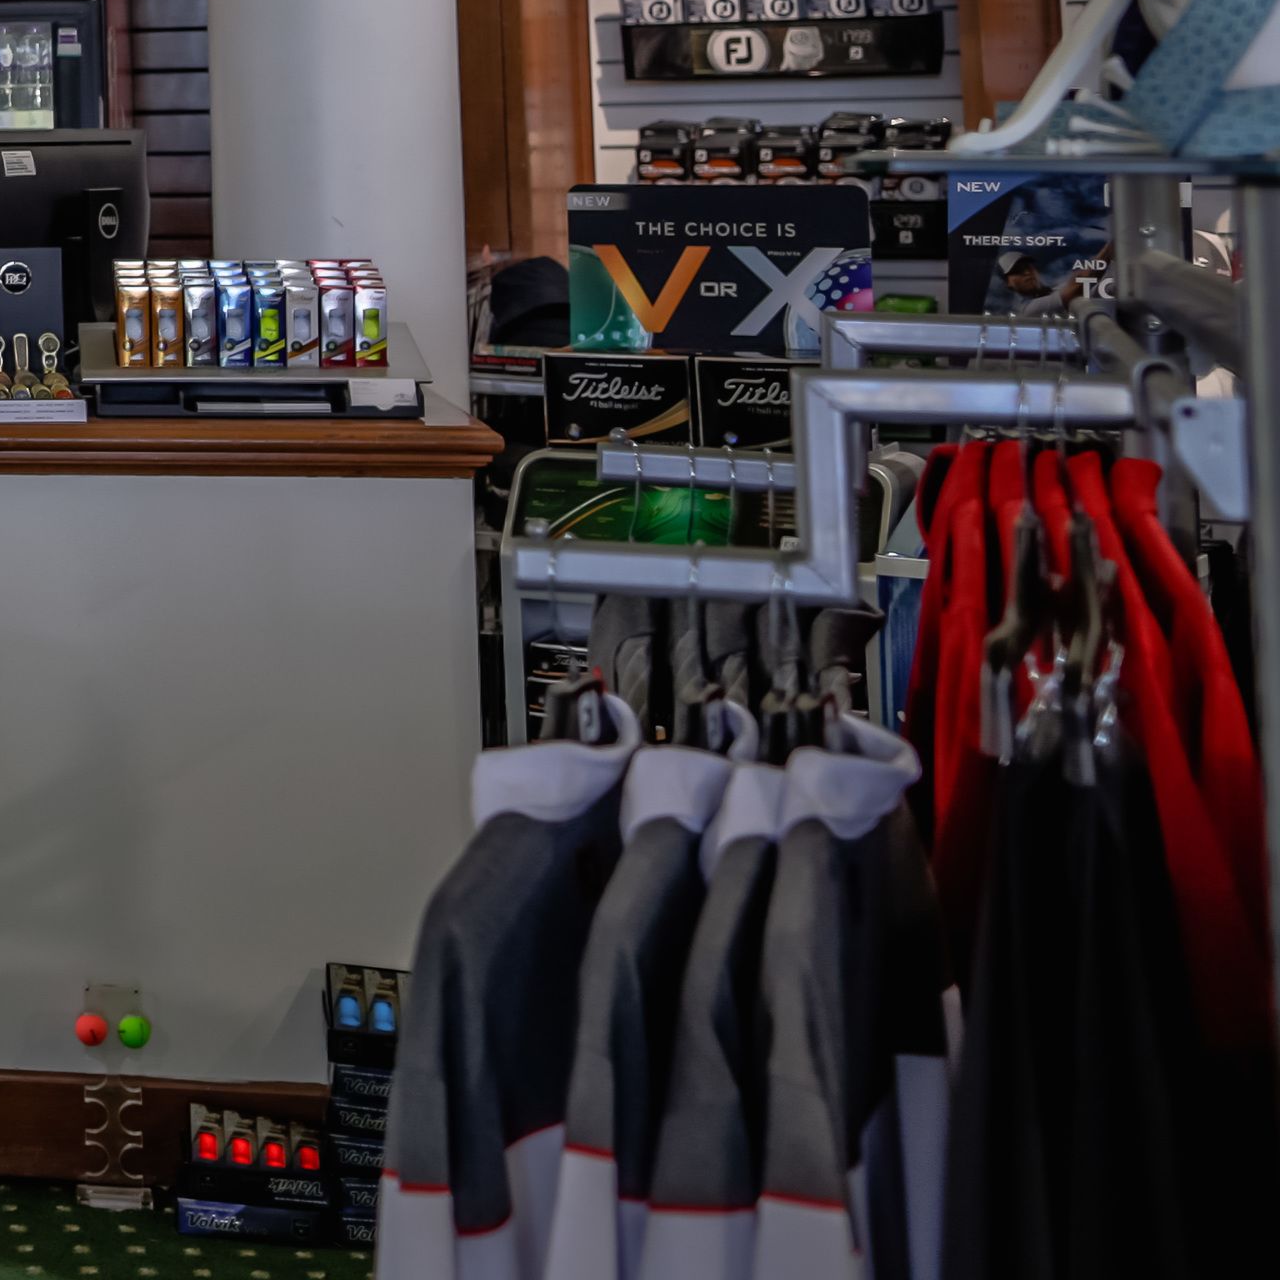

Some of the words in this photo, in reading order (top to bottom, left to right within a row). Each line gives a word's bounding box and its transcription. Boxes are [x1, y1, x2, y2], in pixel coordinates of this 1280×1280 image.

[956, 181, 1001, 193] NEW
[572, 195, 611, 207] NEW
[635, 221, 675, 236] THE
[684, 221, 767, 238] CHOICE
[777, 223, 797, 238] IS
[962, 235, 1022, 246] THERE'S
[1026, 235, 1067, 246] SOFT.
[1072, 259, 1108, 270] AND
[592, 244, 711, 333] V
[699, 281, 738, 298] OR
[726, 246, 845, 336] X
[562, 372, 666, 402] Titleist
[717, 378, 791, 407] Title
[344, 1076, 392, 1098] Volvi
[340, 1110, 386, 1130] Volvi
[338, 1147, 384, 1168] Volvi
[268, 1177, 324, 1197] Volvik
[350, 1190, 378, 1207] Vol
[186, 1211, 244, 1232] Volvik
[347, 1224, 376, 1241] Vol
